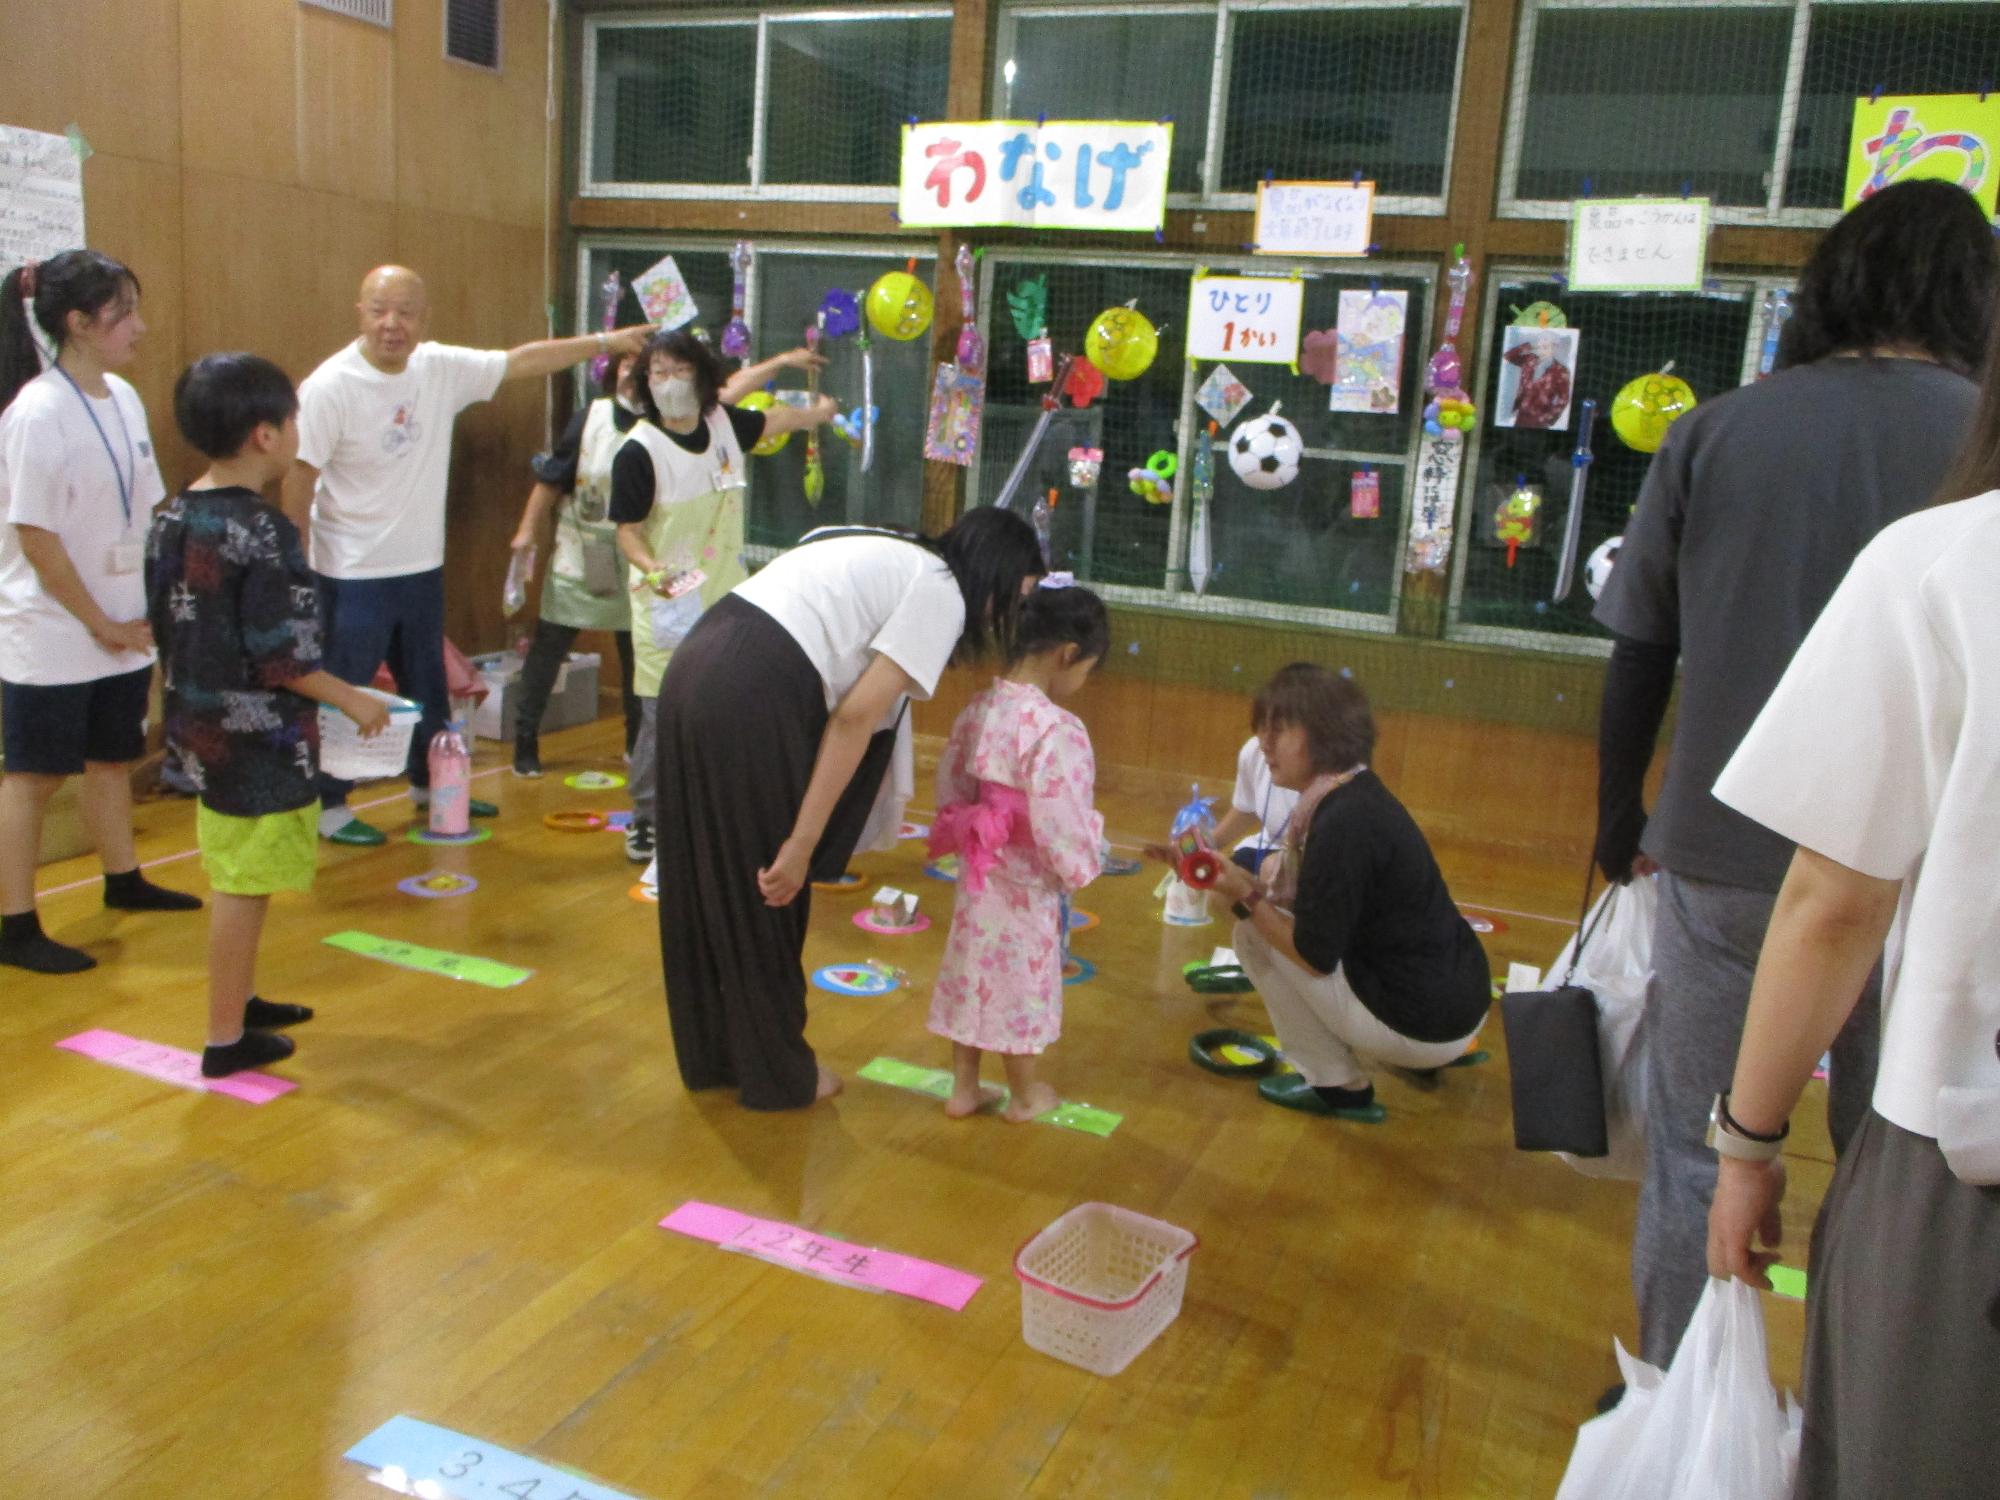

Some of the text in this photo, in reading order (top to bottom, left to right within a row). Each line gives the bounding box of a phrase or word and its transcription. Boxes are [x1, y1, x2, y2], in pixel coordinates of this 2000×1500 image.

[925, 133, 1155, 211] わなげ
[1209, 290, 1272, 315] ひとり
[1222, 321, 1277, 352] 1かい
